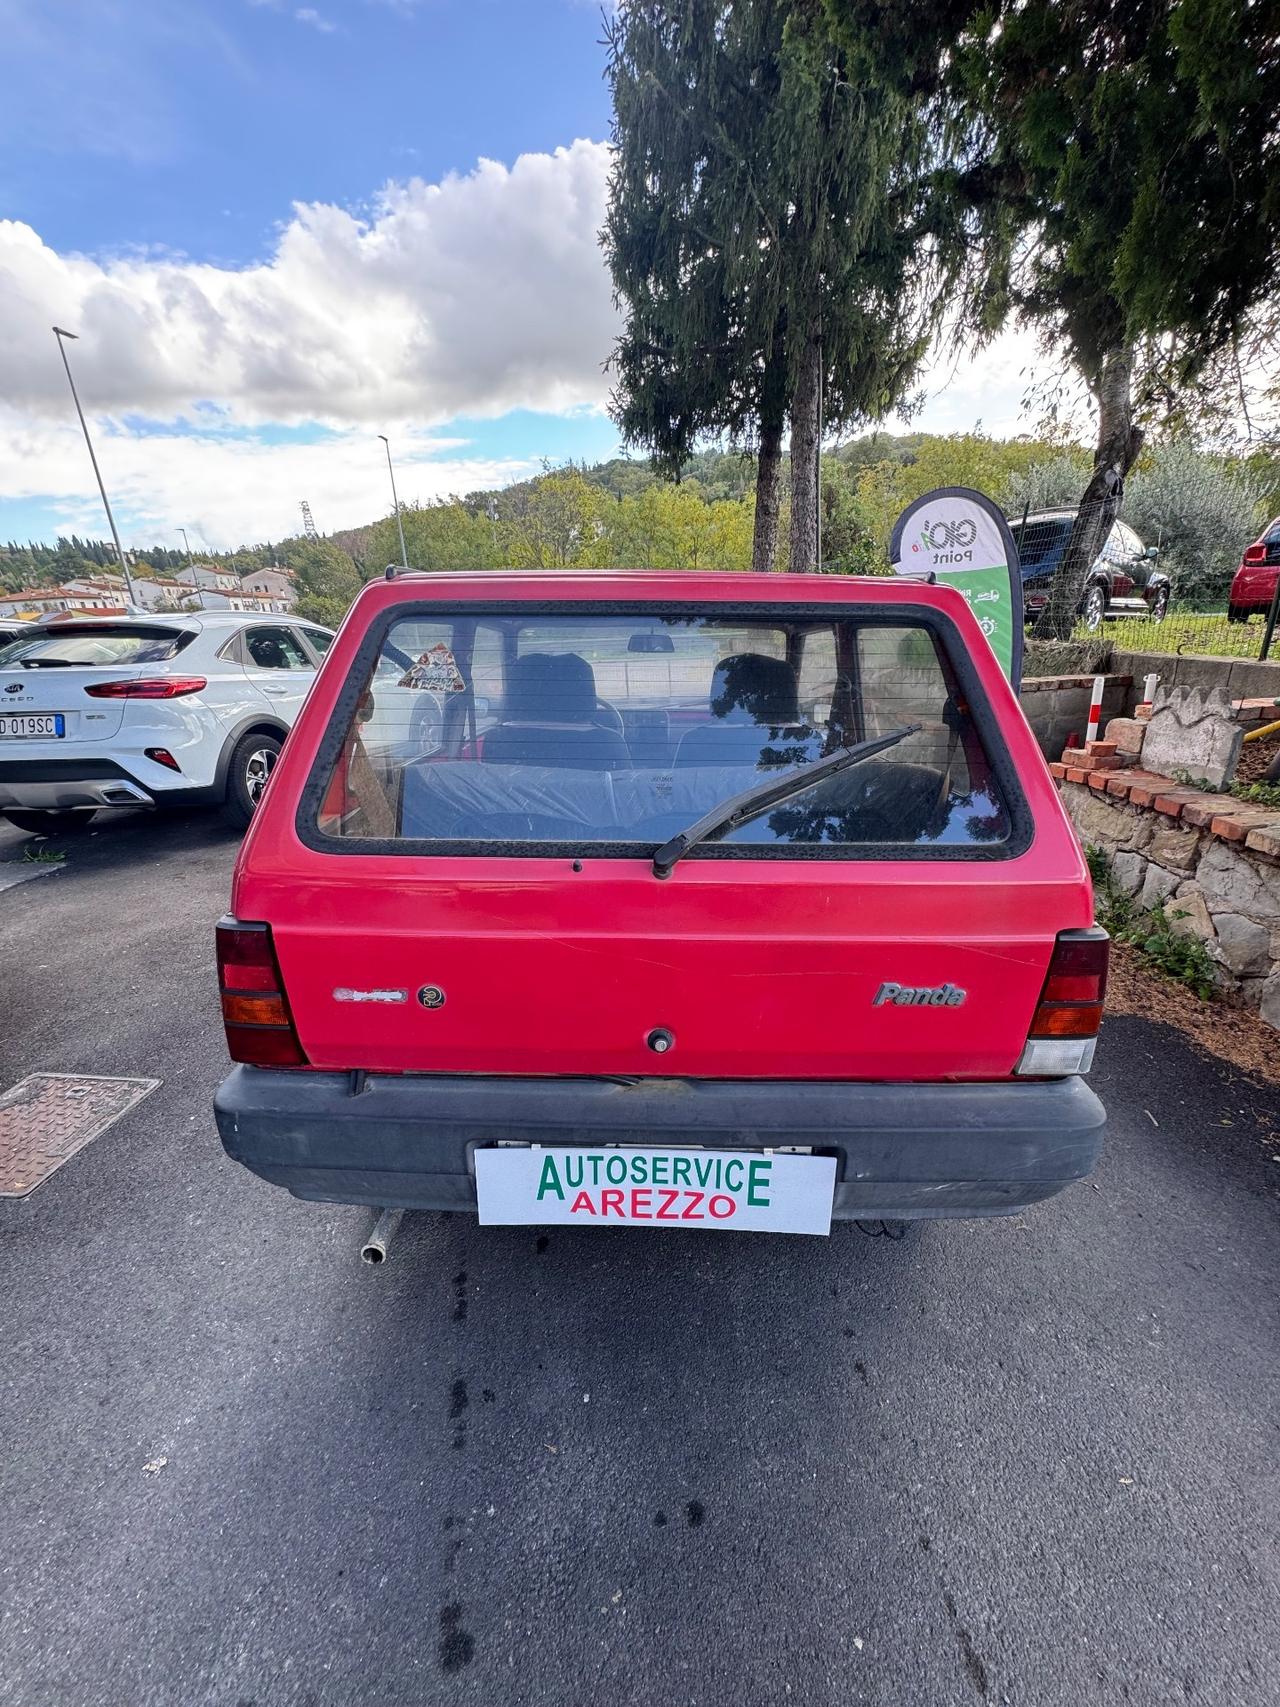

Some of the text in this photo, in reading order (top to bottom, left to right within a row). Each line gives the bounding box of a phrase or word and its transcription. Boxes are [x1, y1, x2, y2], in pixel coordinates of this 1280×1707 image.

[872, 982, 967, 1006] Panda
[536, 1155, 772, 1207] AUTOSERVICE
[570, 1189, 737, 1219] AREZZO
